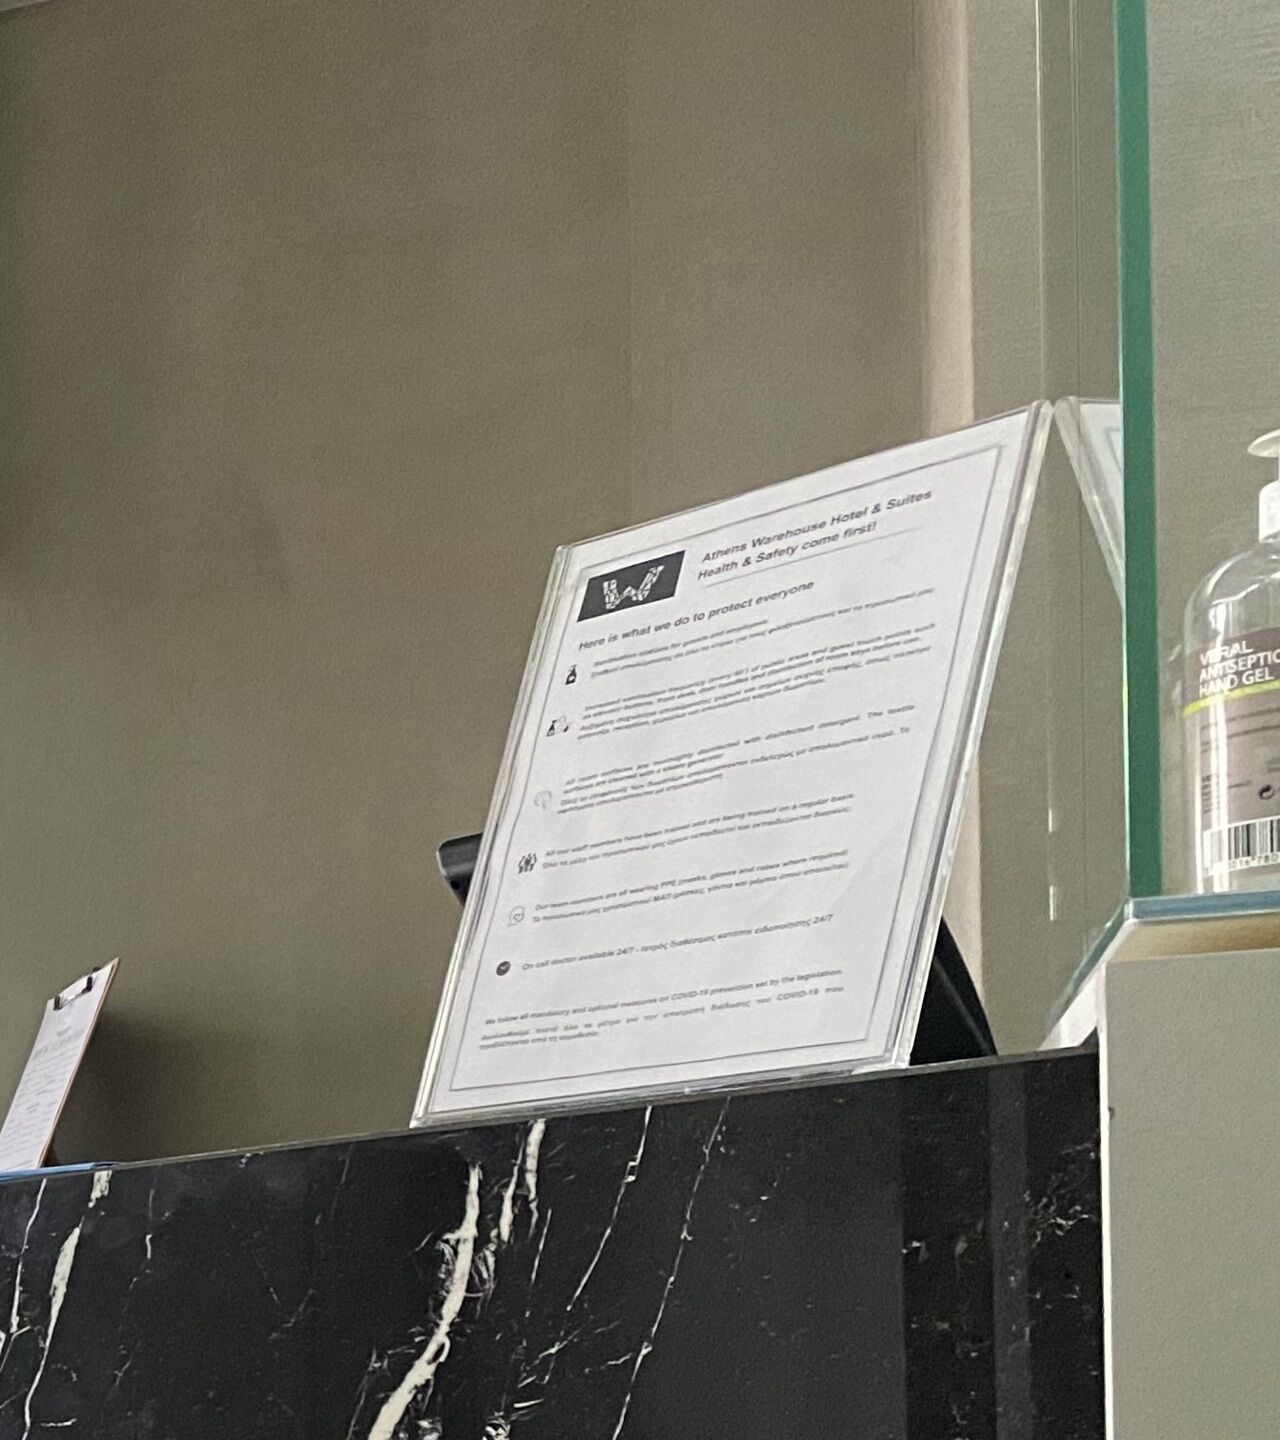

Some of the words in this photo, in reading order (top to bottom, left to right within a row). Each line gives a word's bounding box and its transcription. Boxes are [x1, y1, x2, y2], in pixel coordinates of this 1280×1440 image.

[697, 561, 738, 580] Health
[742, 556, 751, 566] &
[755, 545, 798, 562] Safety
[801, 533, 839, 549] come
[843, 521, 876, 538] first!
[702, 543, 747, 562] Athens
[752, 521, 826, 548] Warehouse
[830, 507, 867, 525] Hotel
[871, 503, 881, 514] &
[886, 491, 931, 509] Suites
[579, 638, 605, 650] Here
[607, 634, 618, 642] is
[622, 625, 651, 639] what
[654, 622, 671, 632] we
[674, 616, 690, 626] do
[693, 612, 705, 622] to
[708, 598, 752, 620] protect
[755, 582, 814, 604] everyone
[1199, 674, 1238, 698] HAND
[1242, 667, 1275, 685] GEL
